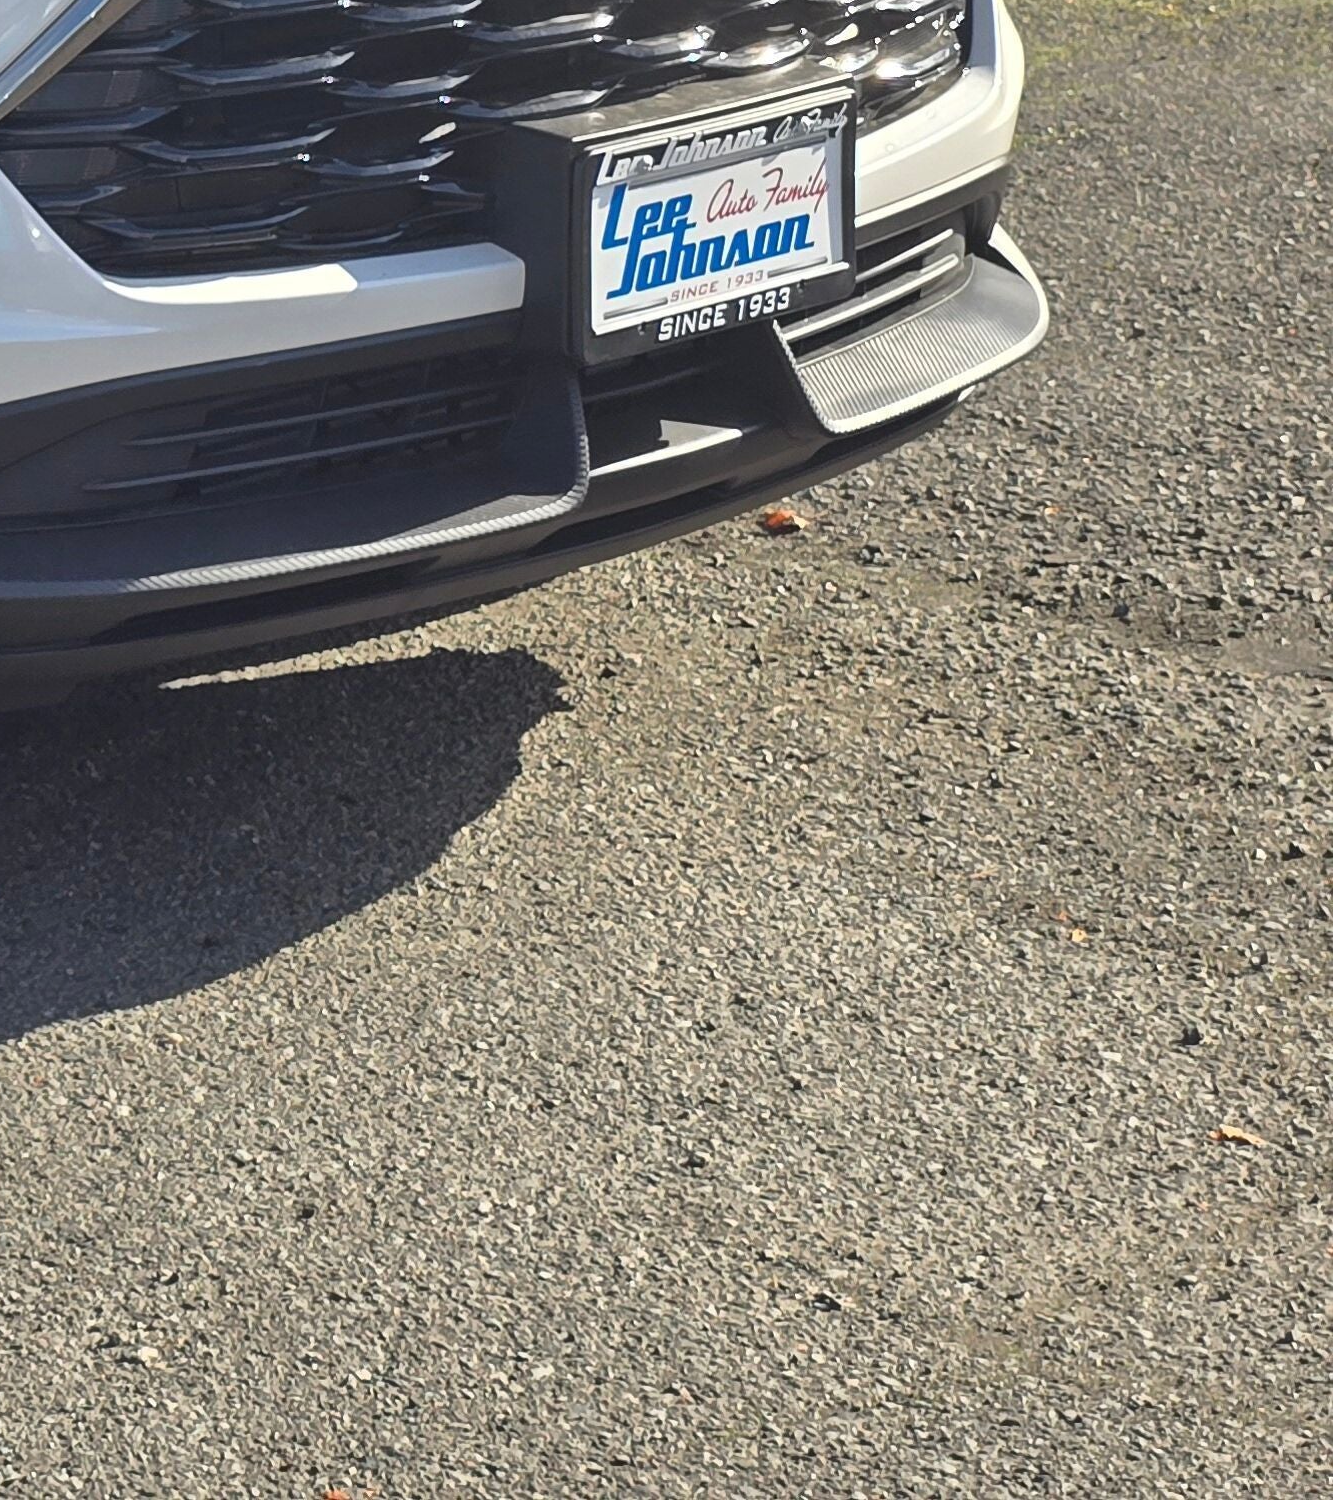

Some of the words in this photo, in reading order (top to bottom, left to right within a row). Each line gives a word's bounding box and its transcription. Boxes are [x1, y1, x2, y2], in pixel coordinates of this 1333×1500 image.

[652, 126, 767, 171] Johnson
[601, 183, 696, 250] Lee
[707, 178, 758, 222] Auto
[762, 167, 829, 214] Family
[606, 214, 815, 300] Johnson
[658, 303, 728, 341] SINCE
[738, 286, 791, 321] 1933
[670, 280, 719, 302] SINCE
[727, 270, 764, 289] 1933
